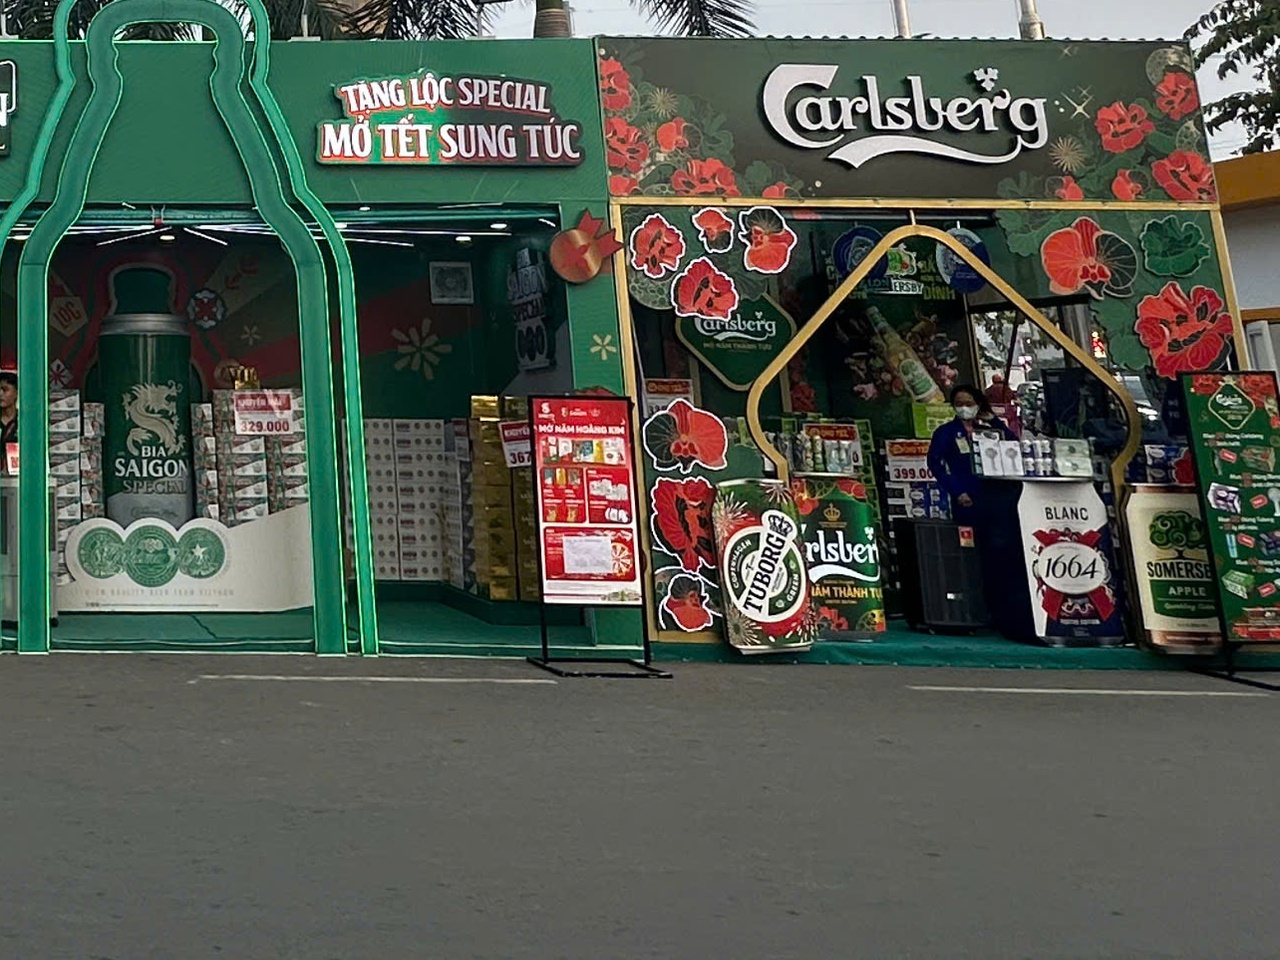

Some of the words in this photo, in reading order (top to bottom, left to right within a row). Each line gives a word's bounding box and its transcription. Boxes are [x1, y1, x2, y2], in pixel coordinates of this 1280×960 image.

[341, 79, 406, 115] TẶNG
[408, 72, 453, 110] LỘC
[458, 77, 551, 113] SPECIAL
[763, 63, 1048, 168] Carlsberg
[322, 115, 372, 158] MỞ
[377, 113, 433, 158] TẾT
[438, 123, 517, 158] SUNG
[521, 116, 581, 158] TÚC
[241, 421, 290, 432] 329.000
[141, 445, 166, 458] BIA
[115, 458, 190, 477] SAIGON
[1045, 507, 1089, 521] BLANC
[743, 532, 788, 614] TUBORG
[1045, 555, 1101, 579] 1664
[786, 572, 800, 602] GREEN
[833, 583, 868, 599] THÀNH
[1168, 586, 1207, 597] APPLE
